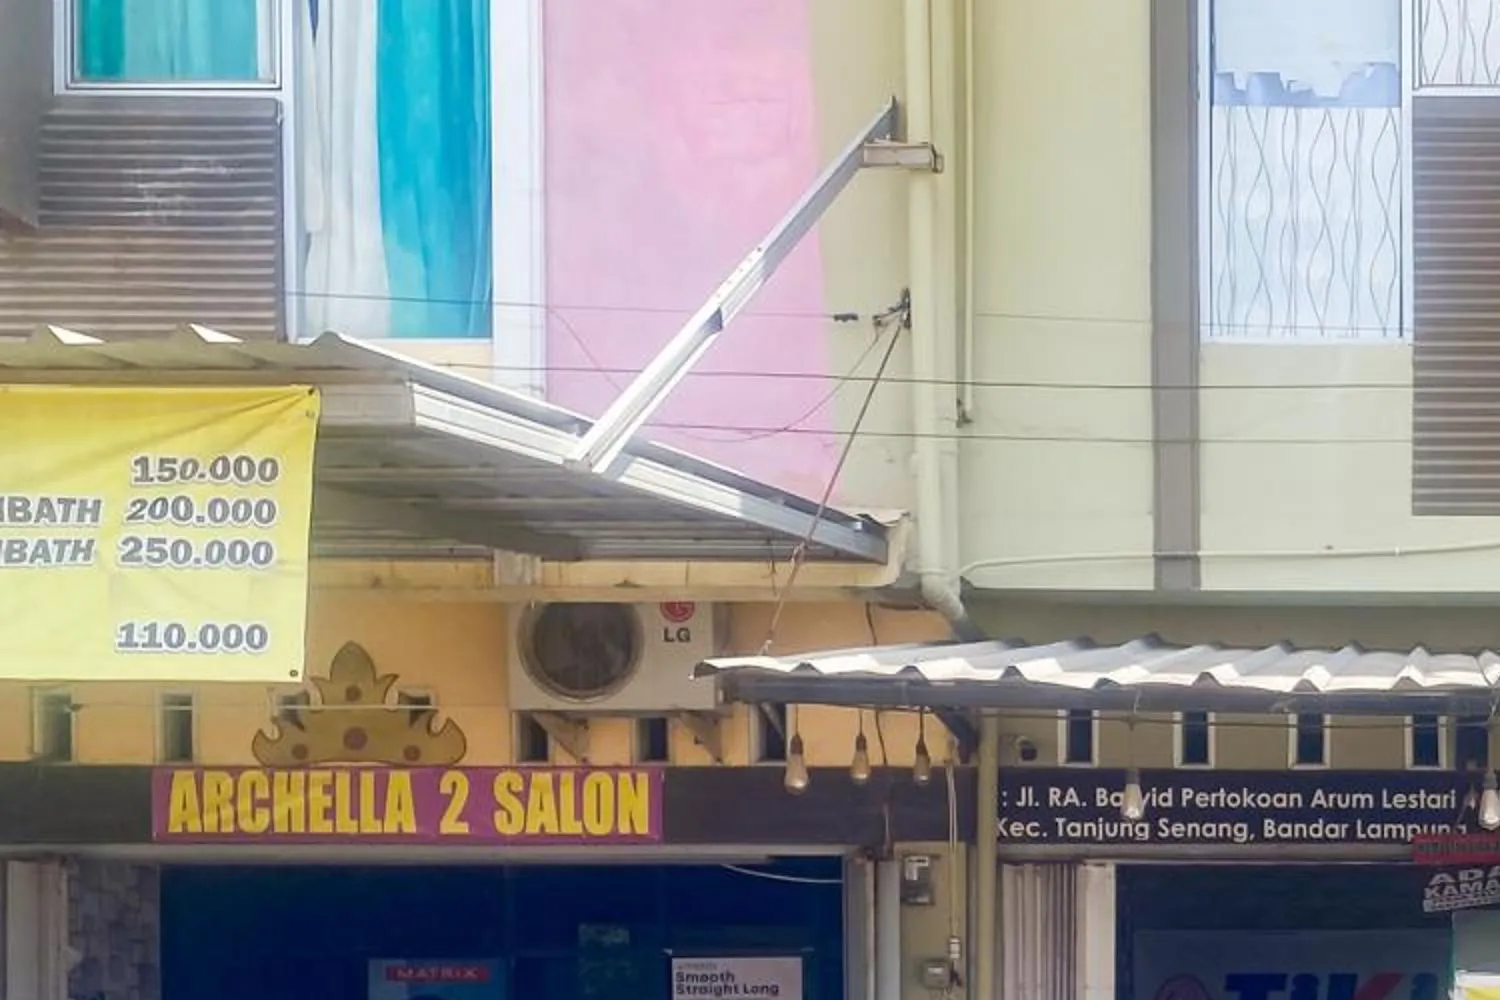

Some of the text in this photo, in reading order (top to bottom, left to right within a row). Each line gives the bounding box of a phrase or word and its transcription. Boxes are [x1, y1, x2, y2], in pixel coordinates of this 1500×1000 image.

[132, 455, 280, 484] 150.000
[0, 496, 277, 525] BATH 200.000
[0, 536, 274, 566] BATH 250.000
[117, 621, 269, 650] 110.000
[663, 627, 691, 643] LG
[167, 770, 650, 836] ARCHELLA 2 SALON
[1048, 786, 1088, 808] RA.
[1180, 788, 1302, 808] Pertokoan
[1311, 788, 1376, 809] Arum
[1382, 788, 1457, 809] Lestari
[1055, 817, 1150, 841] Tanjung
[1157, 818, 1256, 842] Senang,
[1263, 818, 1346, 839] Bandar
[397, 966, 479, 978] MATRIX
[676, 970, 735, 984] Smooth
[676, 983, 780, 998] Straight Long
